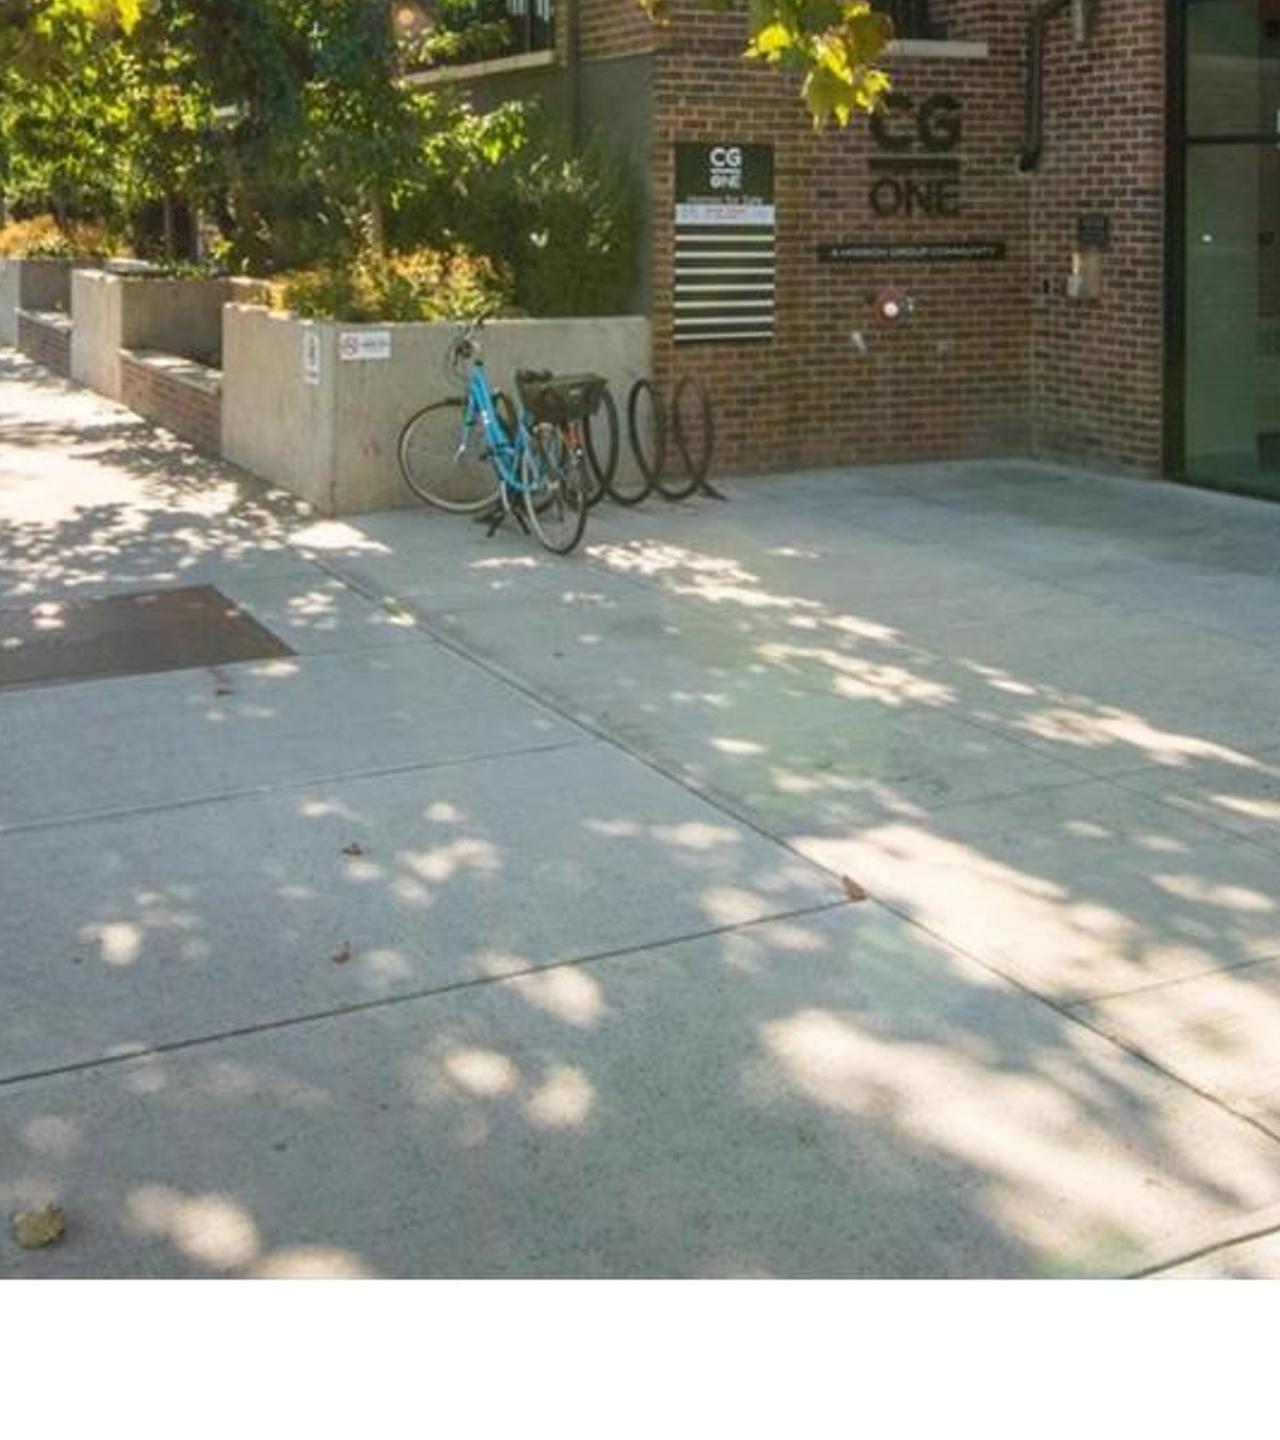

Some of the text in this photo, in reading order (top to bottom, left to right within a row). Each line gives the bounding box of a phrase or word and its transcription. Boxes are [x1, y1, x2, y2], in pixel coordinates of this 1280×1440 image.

[869, 94, 962, 153] CG
[709, 146, 742, 168] CG
[868, 177, 961, 218] ONE
